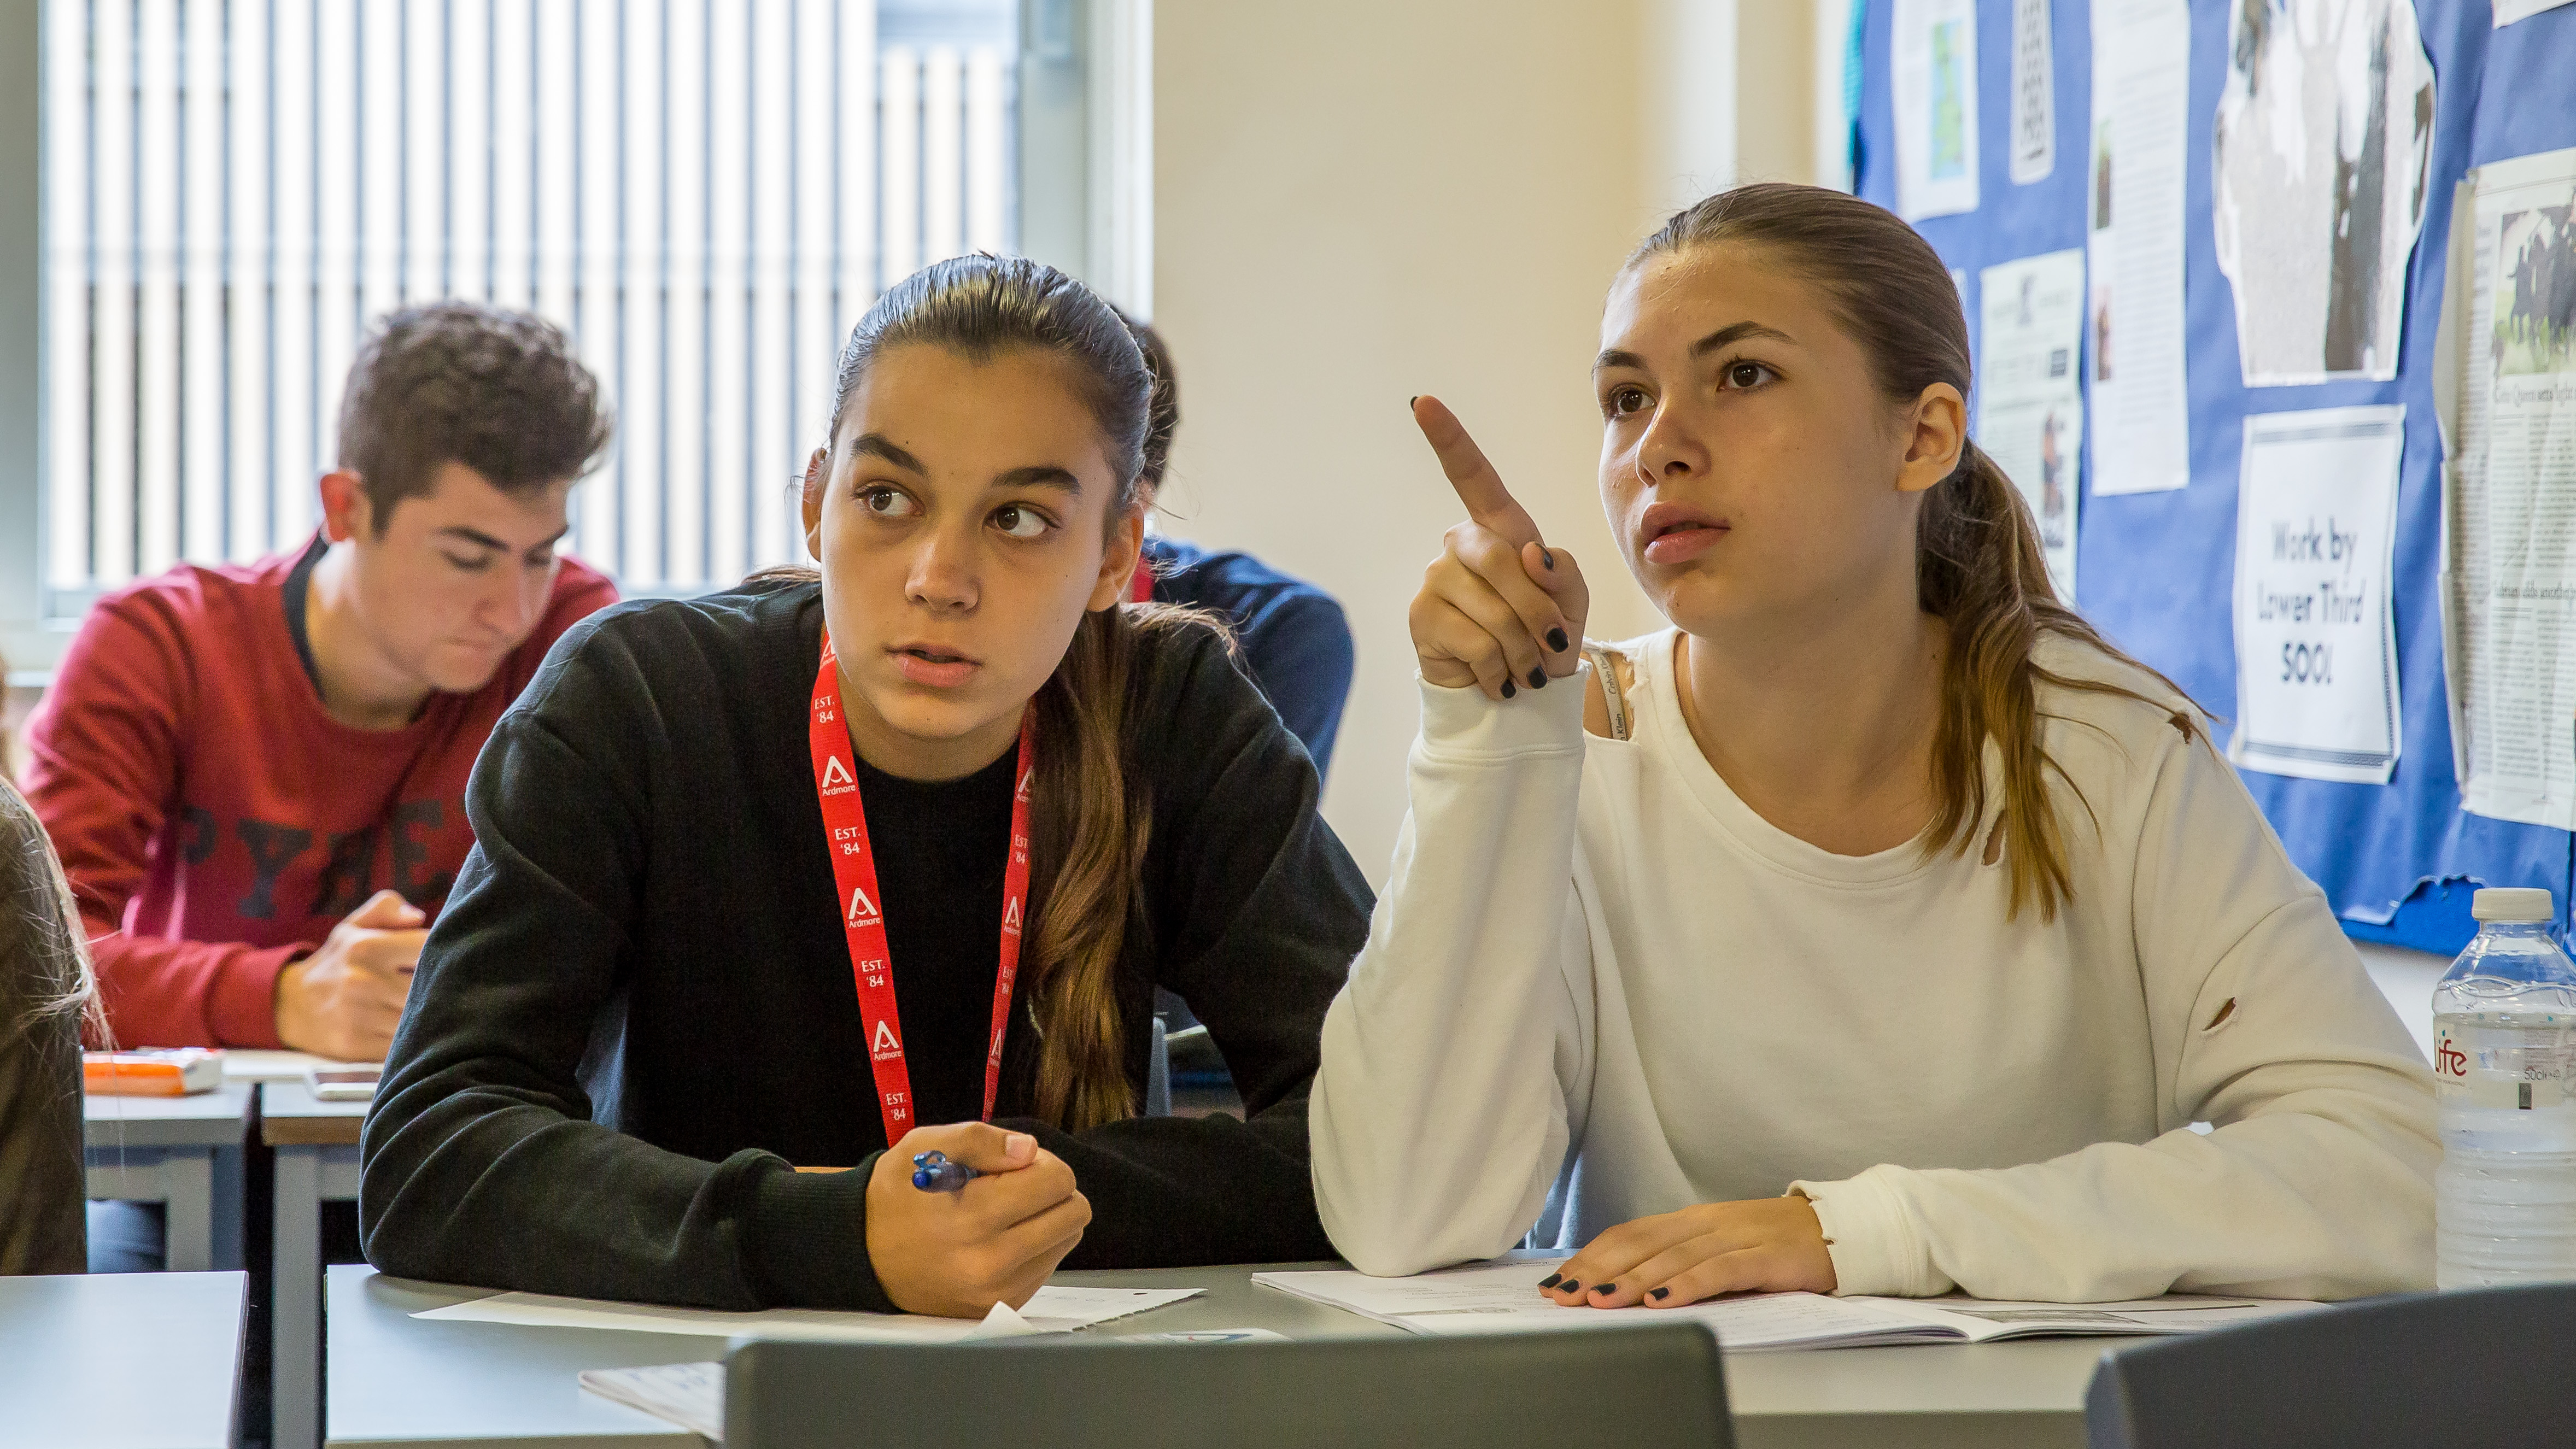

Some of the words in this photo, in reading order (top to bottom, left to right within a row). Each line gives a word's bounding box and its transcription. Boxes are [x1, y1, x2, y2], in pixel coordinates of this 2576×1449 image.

[2271, 516, 2322, 561] Work
[2329, 515, 2358, 574] by
[2257, 580, 2313, 622] Lower
[2320, 578, 2366, 622] Third
[815, 695, 835, 710] EST.
[1615, 713, 1624, 734] Klein
[822, 784, 856, 797] Ardmore
[834, 826, 860, 840] EST.
[849, 917, 881, 928] Ardmore
[861, 959, 886, 972] EST.
[874, 1050, 902, 1061] Ardmore
[886, 1093, 907, 1105] EST.
